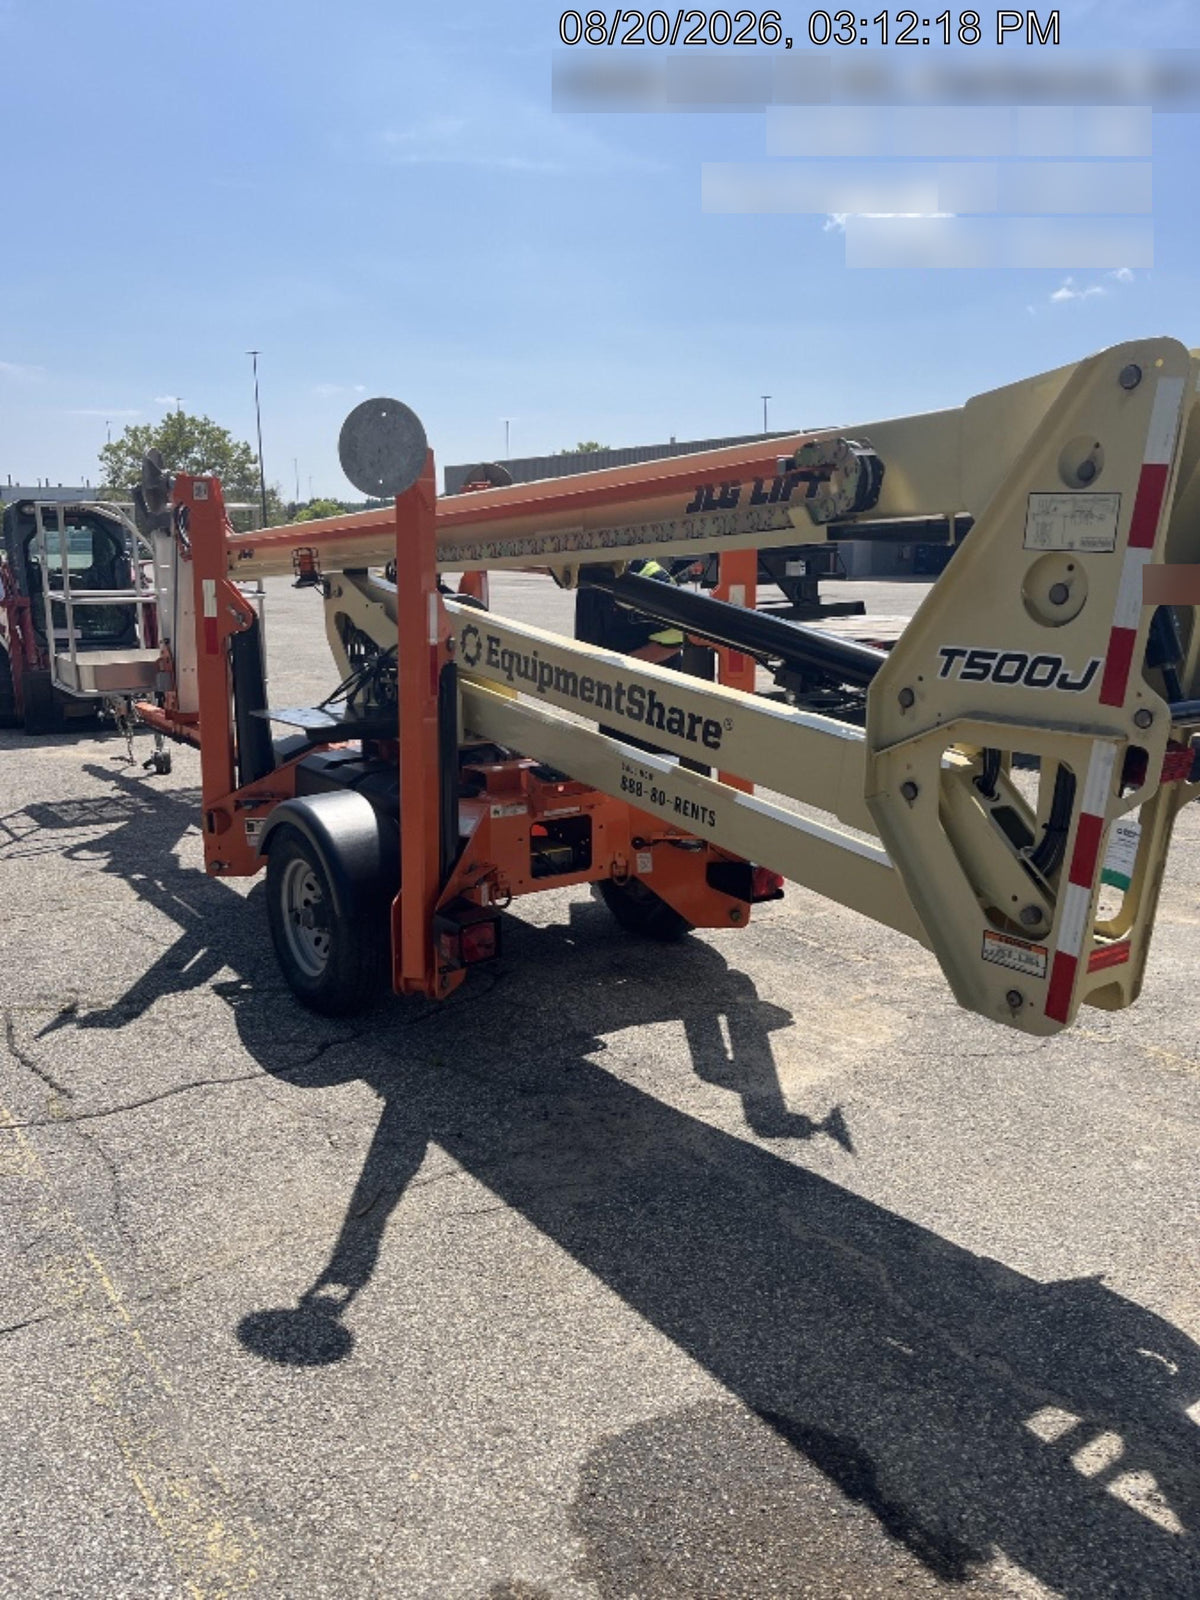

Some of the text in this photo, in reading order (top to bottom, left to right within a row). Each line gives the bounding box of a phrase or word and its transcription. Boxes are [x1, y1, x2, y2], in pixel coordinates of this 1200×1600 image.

[686, 479, 742, 514] JLG
[486, 634, 723, 750] EquipmentShare
[938, 647, 1102, 694] T500J
